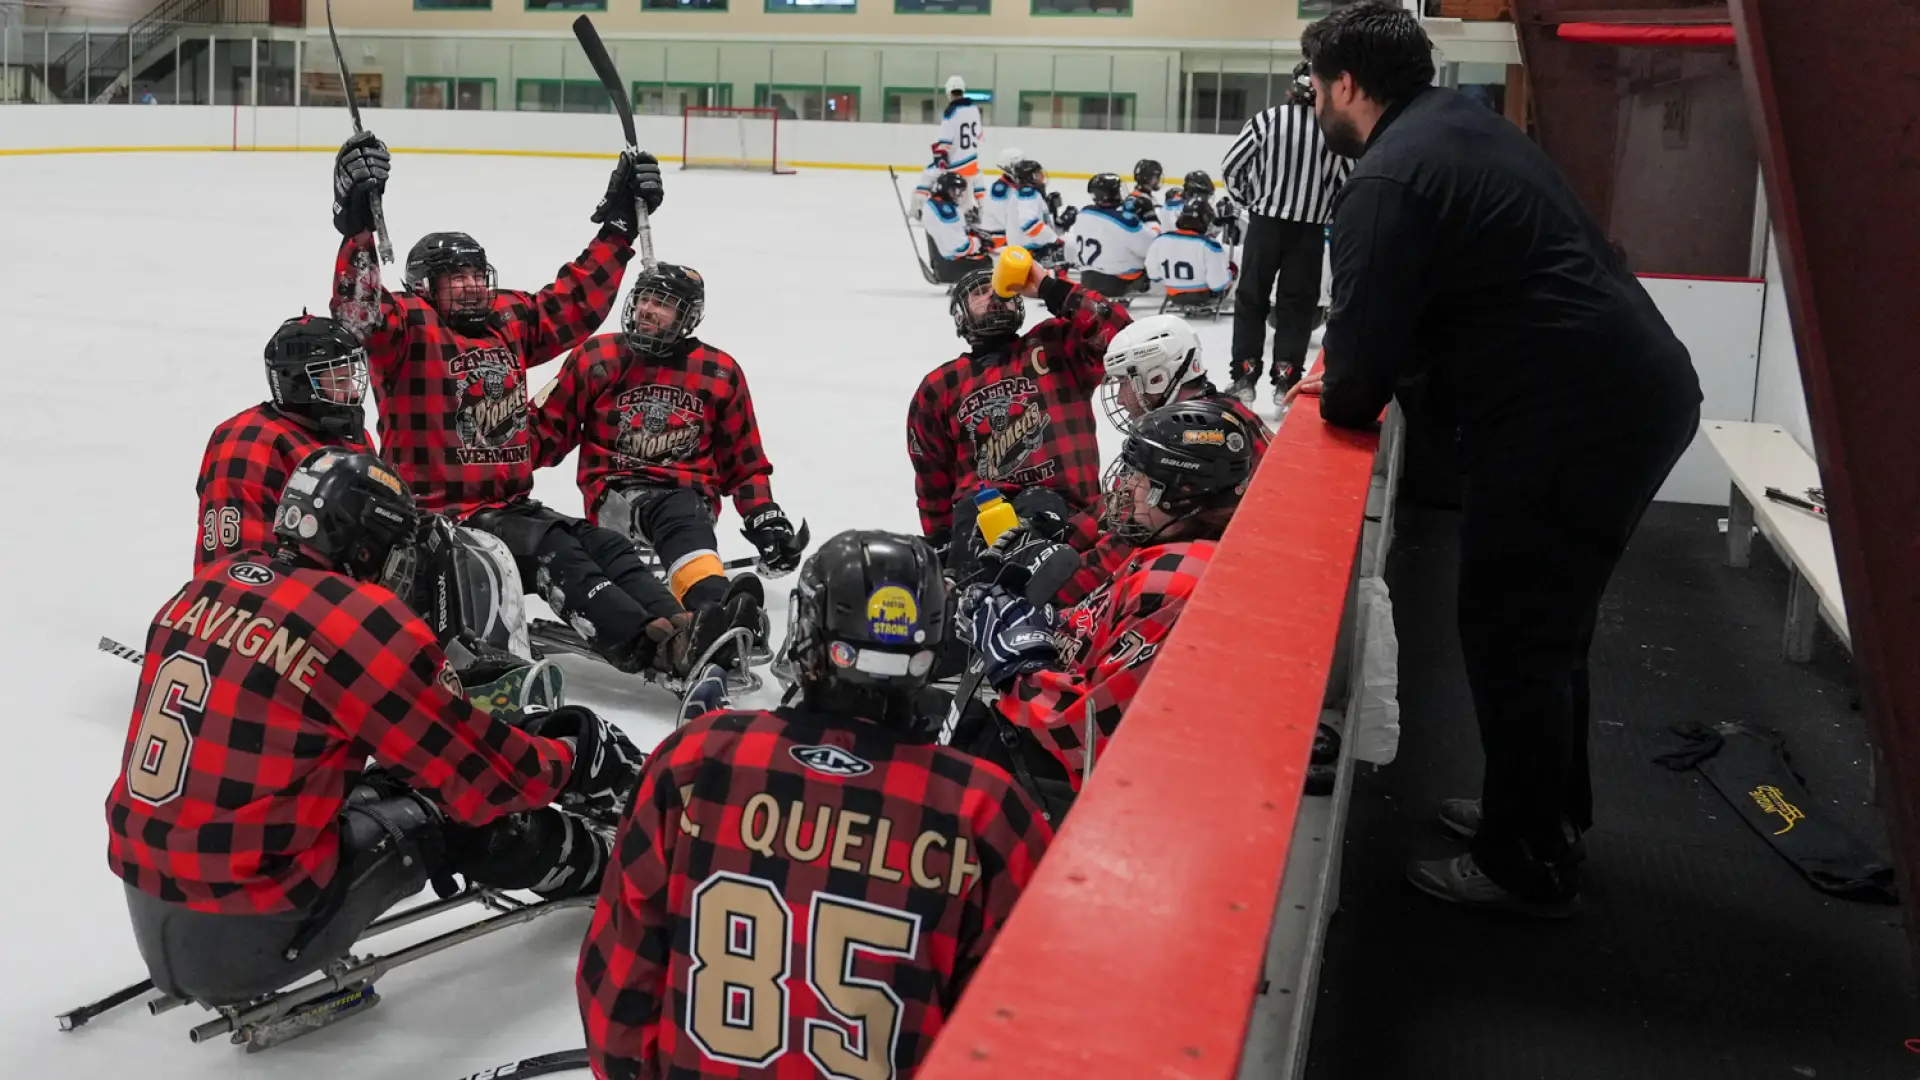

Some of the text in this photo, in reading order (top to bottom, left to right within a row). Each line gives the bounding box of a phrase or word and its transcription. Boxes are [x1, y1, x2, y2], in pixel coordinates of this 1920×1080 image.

[1160, 259, 1195, 280] 10
[1031, 346, 1050, 375] C
[617, 384, 704, 417] CENTRAL
[1160, 457, 1199, 469] BAUER
[203, 506, 240, 551] 36
[438, 571, 447, 633] Reebok
[159, 590, 330, 694] LAVIGNE
[872, 622, 908, 636] STRONG
[127, 650, 212, 807] 6
[740, 792, 982, 895] QUELCH
[685, 870, 922, 1080] 85
